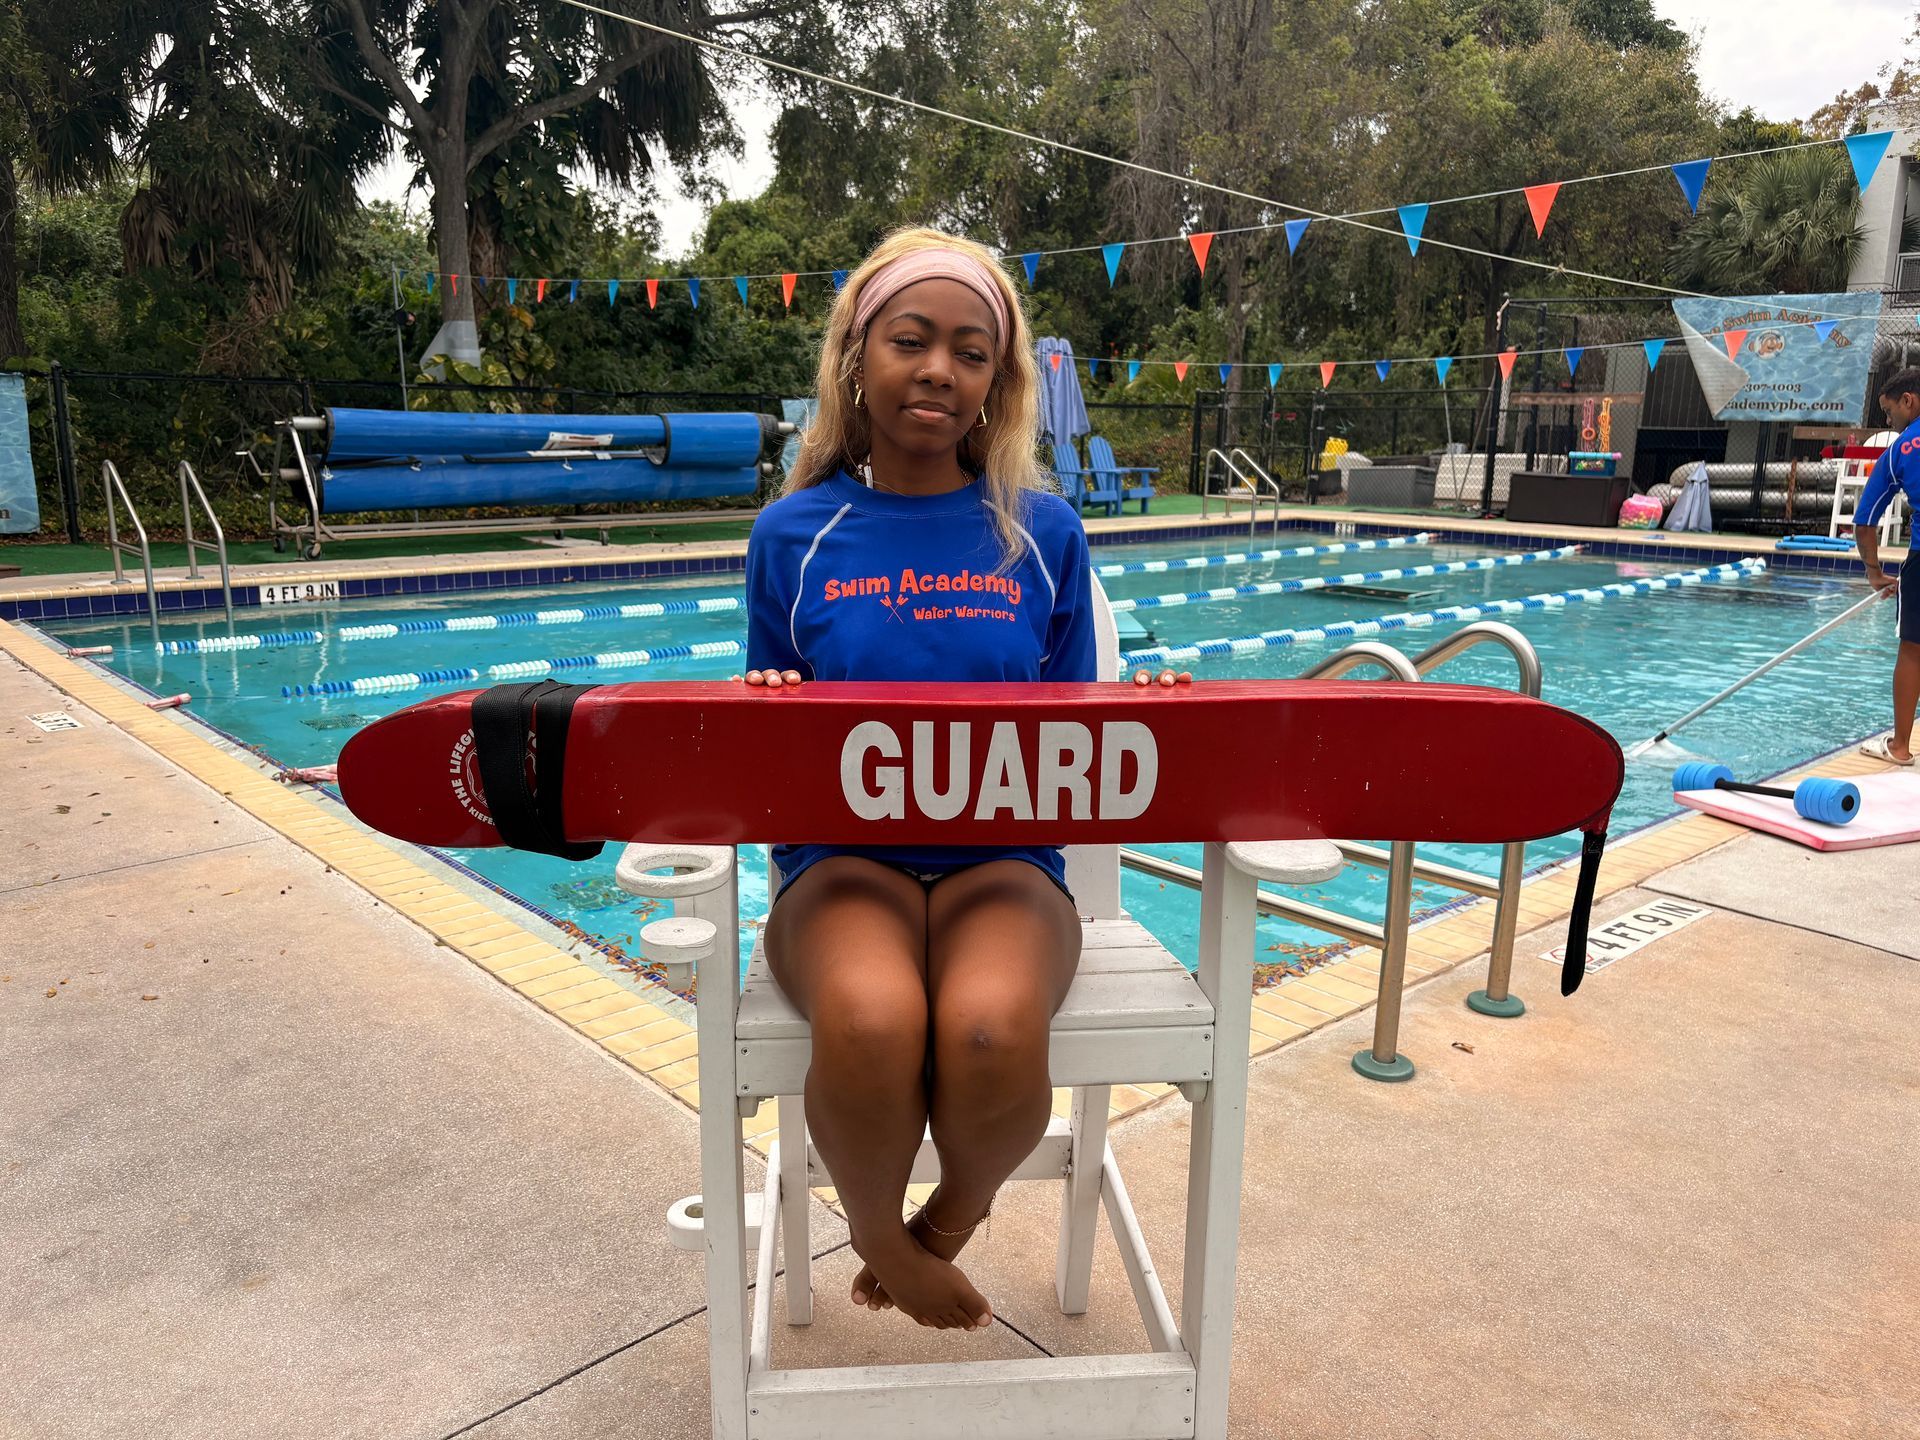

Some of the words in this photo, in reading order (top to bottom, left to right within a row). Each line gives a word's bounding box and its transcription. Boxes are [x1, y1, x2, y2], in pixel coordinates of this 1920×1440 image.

[1723, 310, 1771, 331] Swim
[266, 587, 275, 600] 4
[306, 585, 314, 597] 9
[824, 576, 891, 601] Swim
[900, 568, 1021, 605] Academy
[913, 606, 952, 620] Water
[955, 605, 1016, 622] Warriors
[840, 720, 1159, 821] GUARD
[450, 778, 472, 808] THE
[468, 806, 495, 826] KIEFE
[1587, 937, 1627, 950] 4
[1633, 913, 1673, 927] 9
